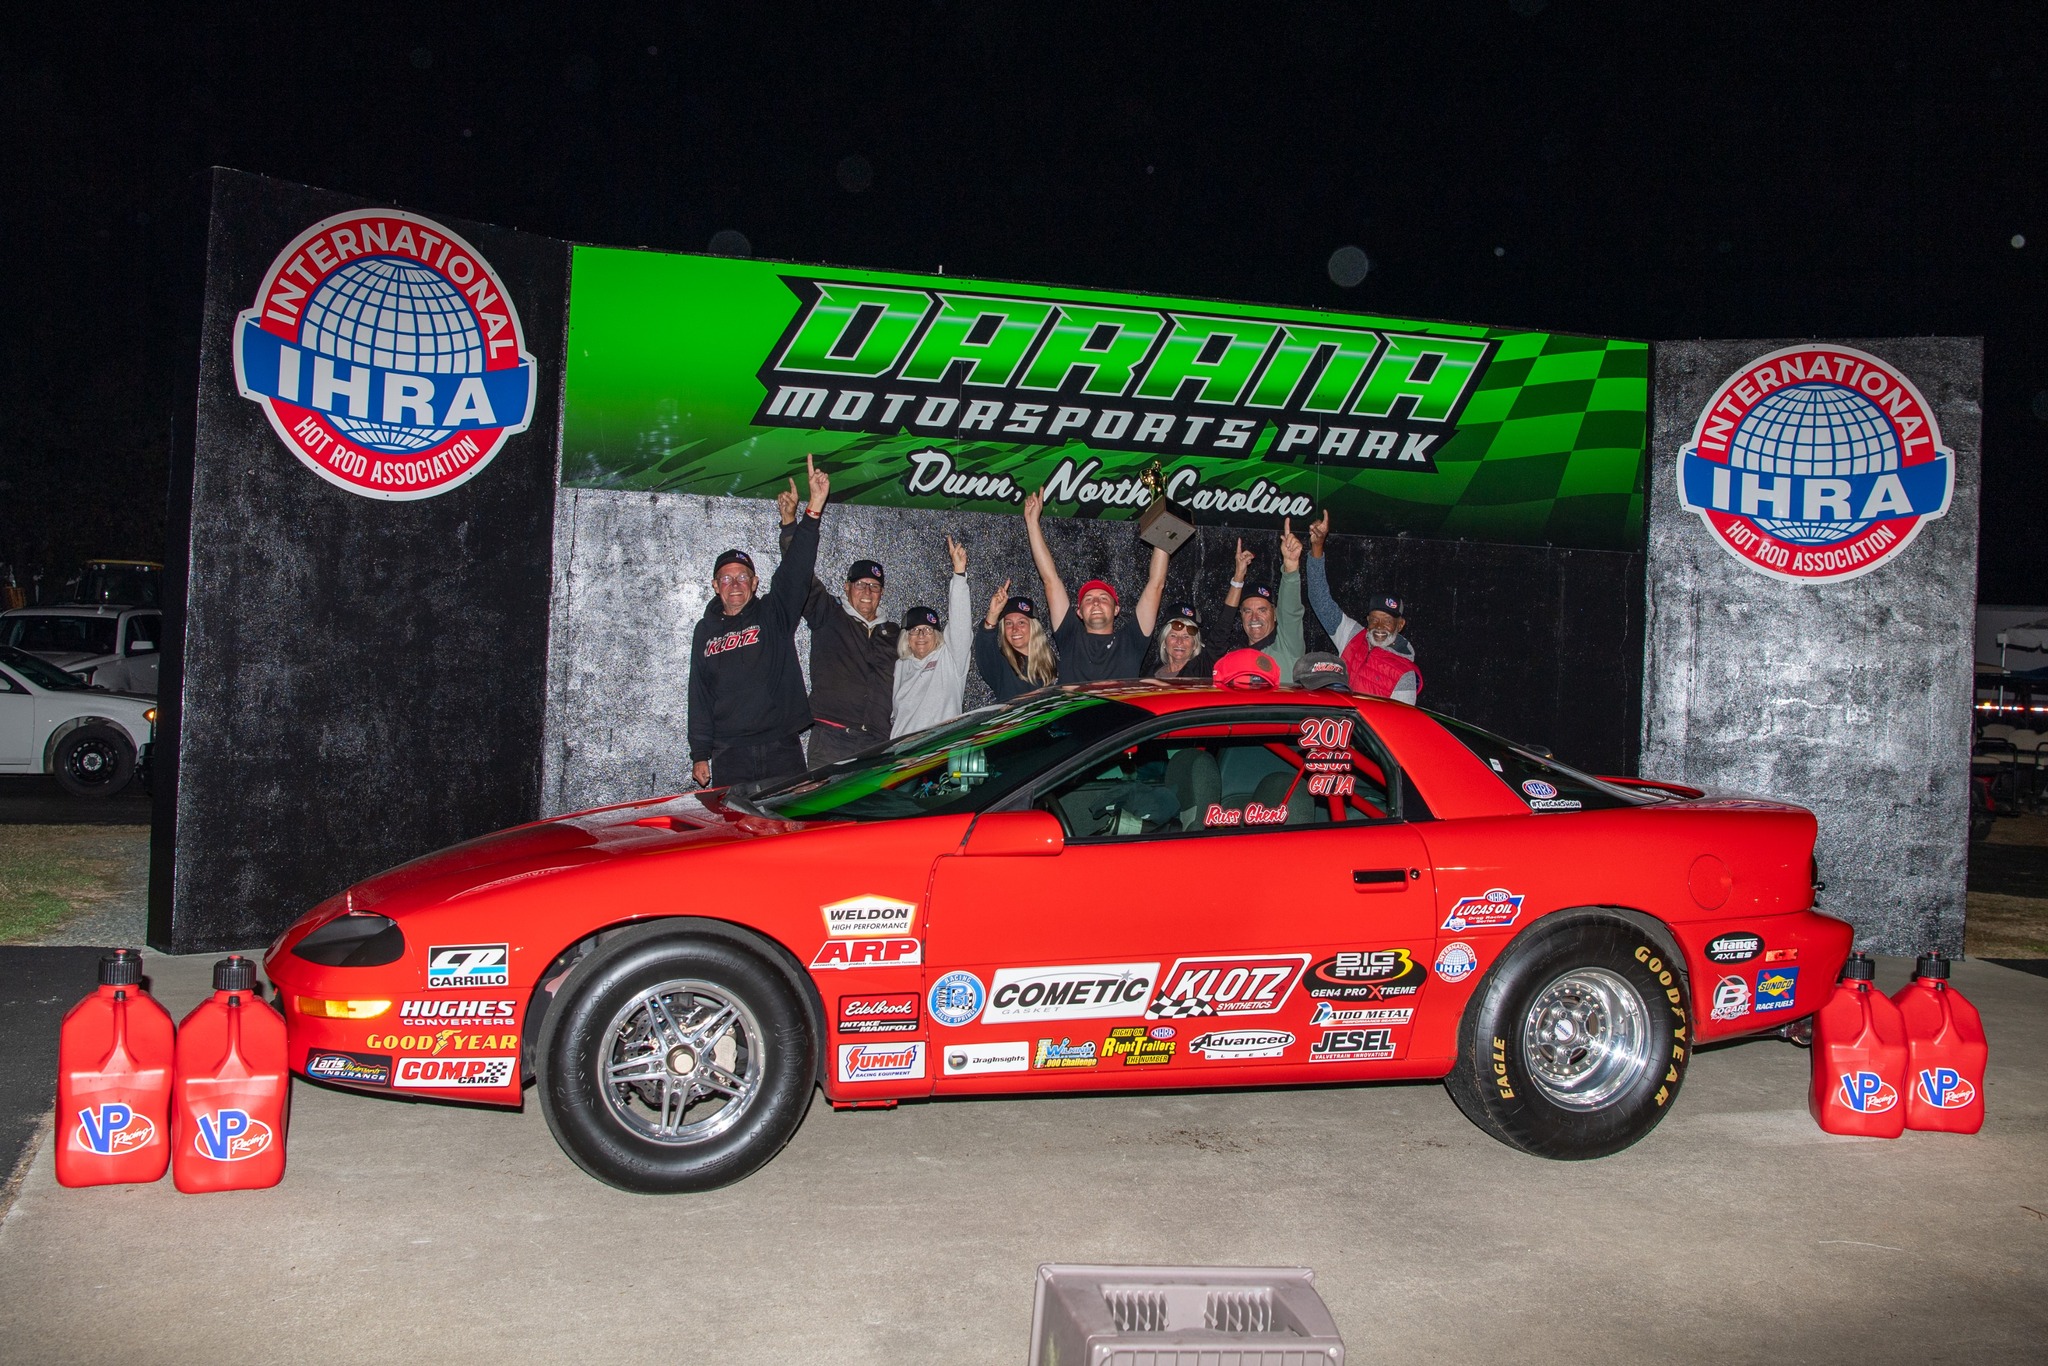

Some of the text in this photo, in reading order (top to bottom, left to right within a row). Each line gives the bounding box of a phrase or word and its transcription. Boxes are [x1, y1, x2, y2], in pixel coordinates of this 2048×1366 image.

[266, 222, 515, 360] INTERNATIONAL
[774, 282, 1490, 422] DARANA
[278, 344, 498, 427] IHRA
[1701, 355, 1930, 456] INTERNATIONAL
[766, 386, 1439, 463] MOTORSPORTS PARK
[294, 415, 480, 486] HOT ROD ASSOCIATION
[906, 450, 1313, 517] Dunn, North Carolina
[1712, 467, 1914, 521] IHRA
[1725, 520, 1897, 572] HOT ROD ASSOCIATION
[706, 629, 761, 657] KLOTZ
[1300, 718, 1352, 748] 201
[1205, 804, 1241, 826] Russ
[830, 908, 909, 921] WELDON
[1456, 904, 1513, 917] LUCAS OIL
[832, 922, 908, 931] HIGH PERFORMANCE
[813, 940, 918, 964] ARP
[1714, 952, 1753, 961] AXLES
[1335, 966, 1394, 977] STUFF
[1336, 948, 1414, 979] BIG 3
[1440, 963, 1471, 974] IHRA
[429, 975, 507, 987] CARRILLO
[945, 974, 972, 984] RACING
[1170, 966, 1294, 1001] KLOTZ
[1759, 979, 1794, 992] SUNOCO
[993, 977, 1150, 1009] COMETIC
[1311, 984, 1417, 1000] GEN4 PRO XTREME
[400, 1001, 517, 1018] HUGHES
[845, 1000, 913, 1016] Edelbrock
[1002, 1007, 1061, 1015] GASKET
[1216, 1001, 1273, 1012] SYNTHETICS
[1756, 1000, 1794, 1010] RACE FUELS
[403, 1018, 516, 1026] CONVERTERS
[1365, 1010, 1410, 1020] METAL
[840, 1020, 881, 1028] INTAKE
[859, 1024, 917, 1033] MANIFOLD
[1112, 1028, 1144, 1037] RIGHT ON
[1151, 1029, 1175, 1038] NHRA
[1312, 1030, 1393, 1053] JESEL
[1190, 1034, 1291, 1051] Advanced
[972, 1055, 1026, 1065] DragInsights
[1126, 1054, 1169, 1065] THE NUMBER
[1493, 1037, 1515, 1099] EAGLE
[324, 1070, 386, 1080] INSURANCE
[402, 1061, 487, 1080] COMP
[458, 1076, 499, 1084] CAMS
[1920, 1067, 1960, 1108] VP
[1840, 1071, 1882, 1111] VP
[1945, 1089, 1974, 1103] Racing
[1867, 1094, 1896, 1108] Racing
[79, 1103, 133, 1154] VP
[113, 1126, 153, 1148] Racing
[197, 1108, 251, 1160] VP
[232, 1132, 269, 1154] Racing
